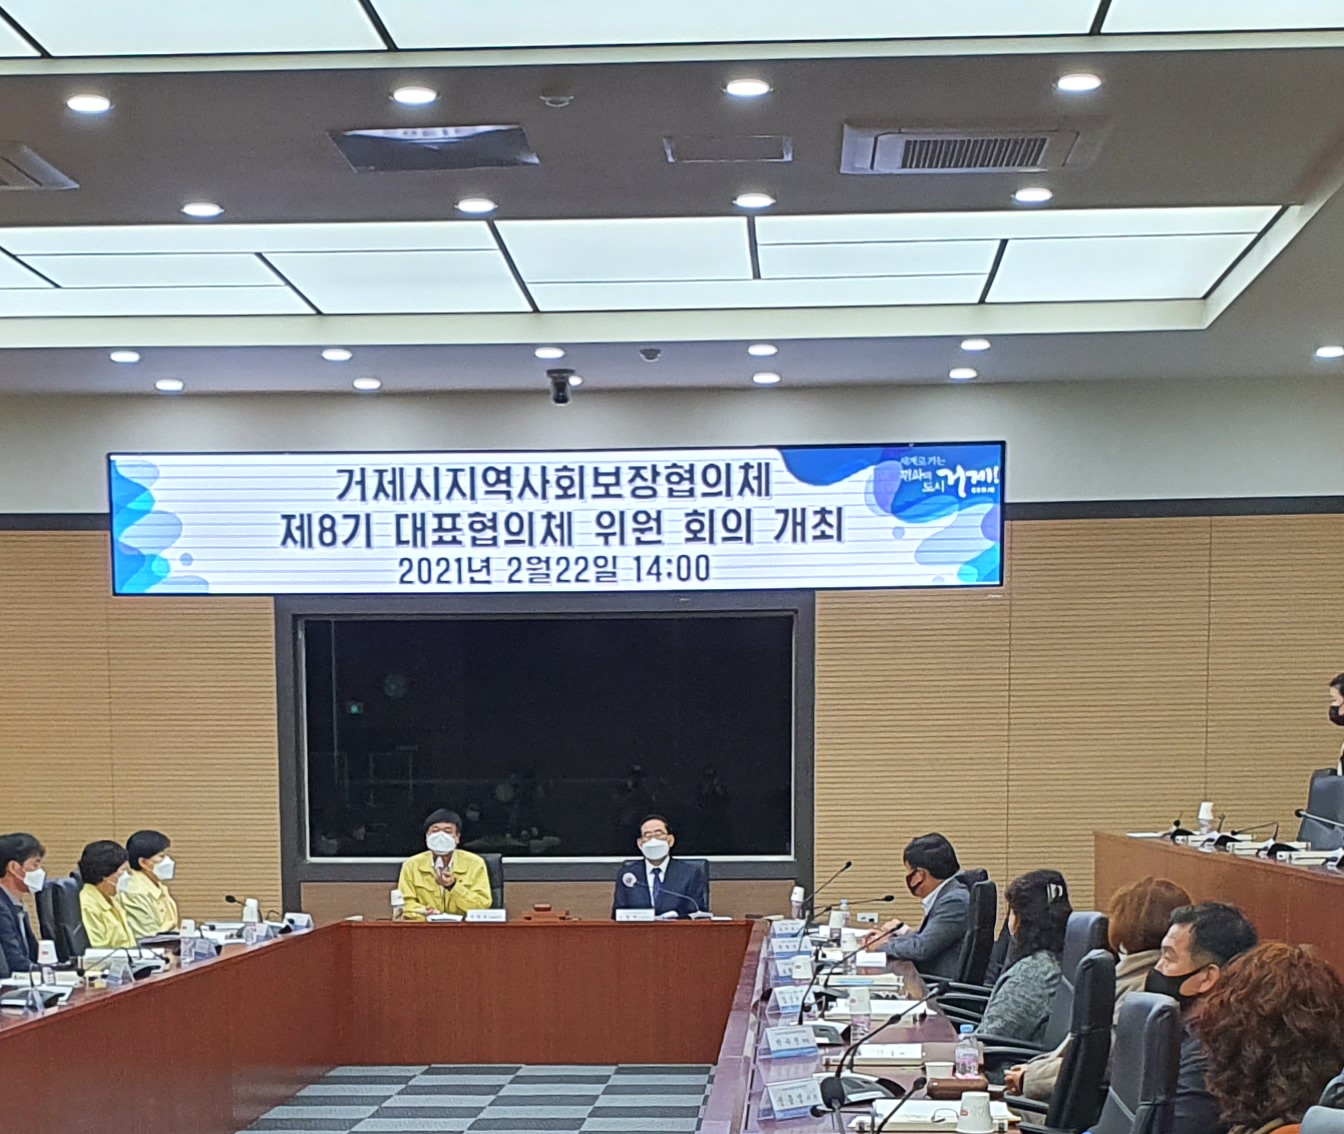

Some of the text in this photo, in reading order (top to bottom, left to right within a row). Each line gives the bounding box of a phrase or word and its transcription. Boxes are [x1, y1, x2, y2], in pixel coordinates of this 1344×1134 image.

[336, 462, 771, 502] 거제시지역사회보장협의체
[922, 480, 944, 493] 도시
[280, 506, 843, 549] 제8기 대표협의체 위원 회의 개최
[399, 554, 711, 585] 2021년 2월22일 14:00
